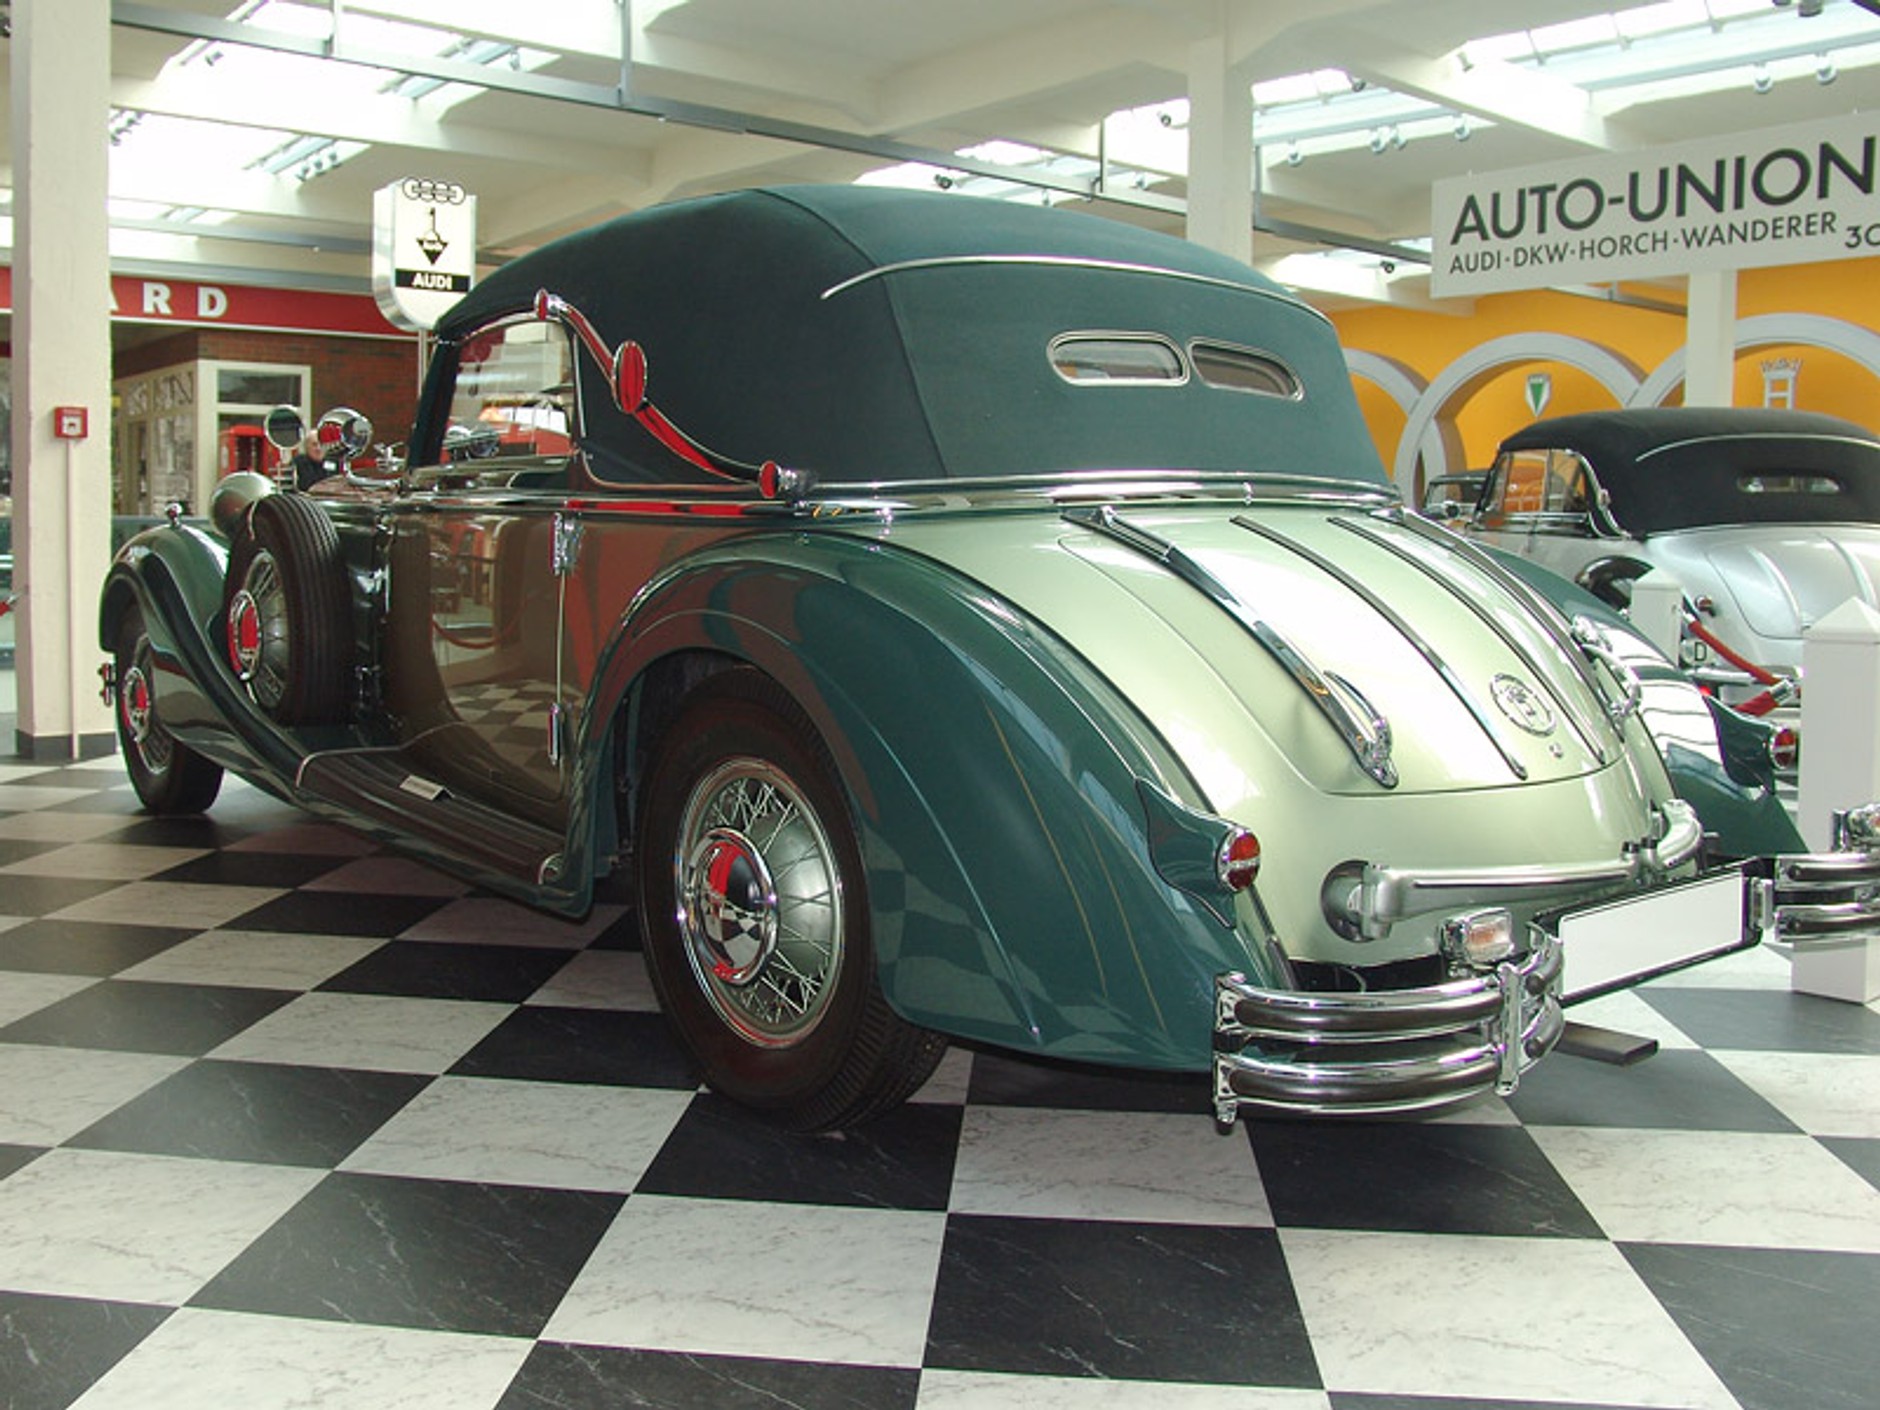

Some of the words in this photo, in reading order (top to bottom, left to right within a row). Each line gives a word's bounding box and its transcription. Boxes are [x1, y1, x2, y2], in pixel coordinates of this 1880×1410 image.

[1450, 135, 1876, 245] AUTO-UNION
[1681, 211, 1837, 249] WANDERER
[411, 273, 453, 290] AUDI
[1694, 642, 1707, 661] D
